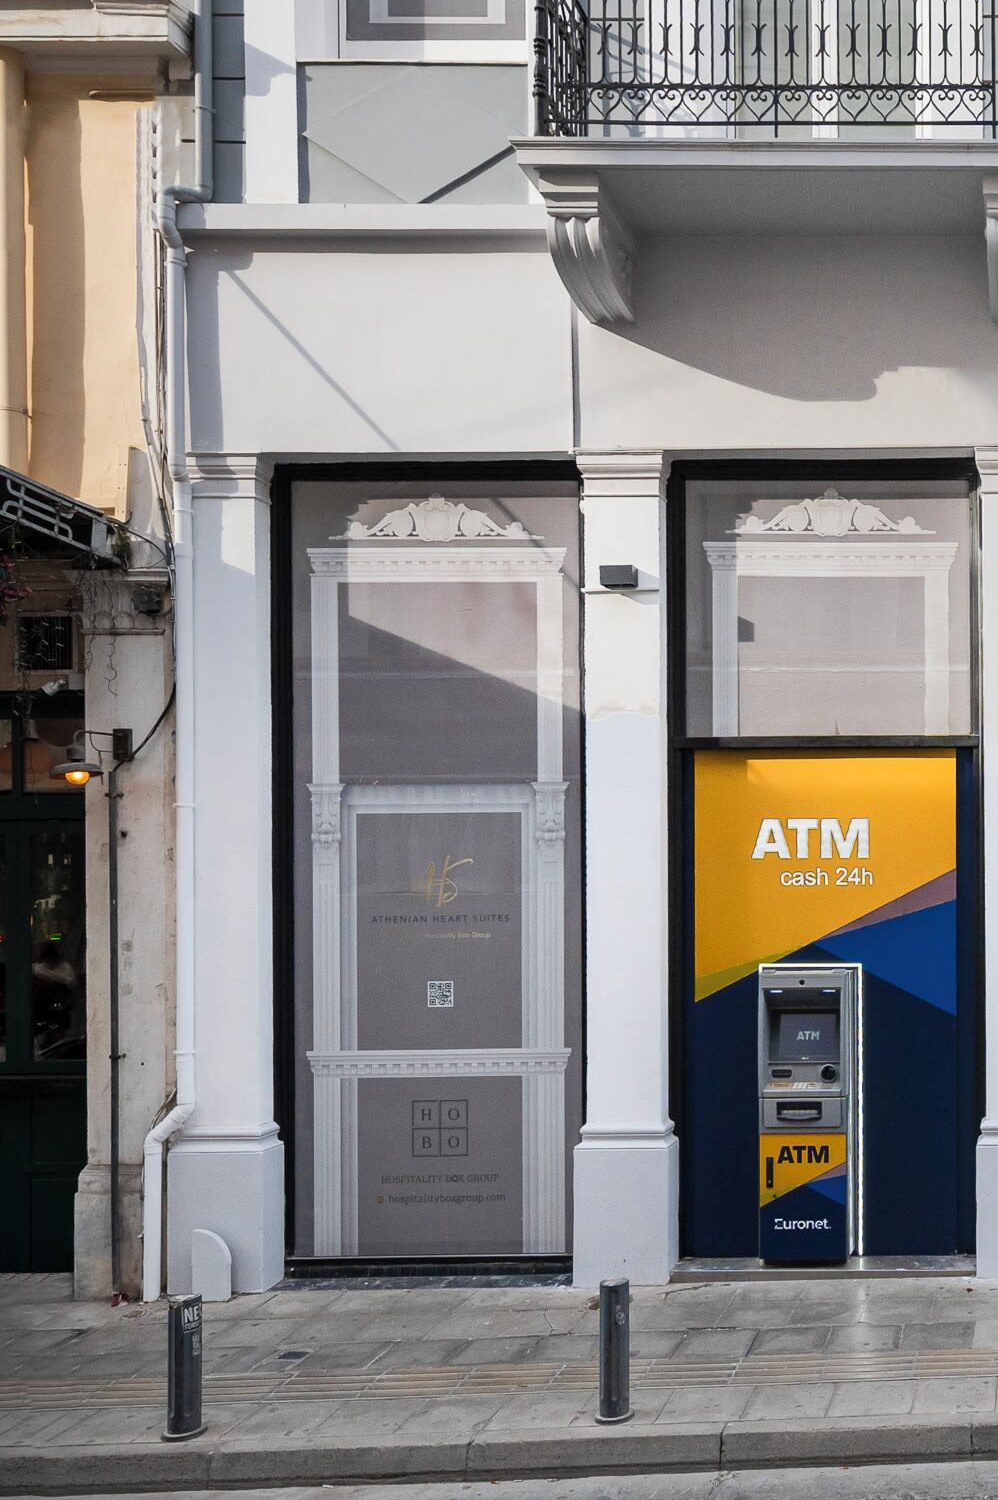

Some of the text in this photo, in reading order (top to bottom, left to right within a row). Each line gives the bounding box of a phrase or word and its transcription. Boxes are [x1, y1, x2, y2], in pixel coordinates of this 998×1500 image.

[751, 817, 871, 860] ATM
[780, 866, 875, 886] cash 24h
[371, 913, 511, 924] ATHENIAN HEART SUITES
[796, 1030, 821, 1041] ATM
[777, 1145, 830, 1164] ATM
[381, 1173, 500, 1184] HOSPITALITY BOX GROUP
[388, 1193, 506, 1205] hospitalityboxgroup.com
[184, 1303, 202, 1323] NE
